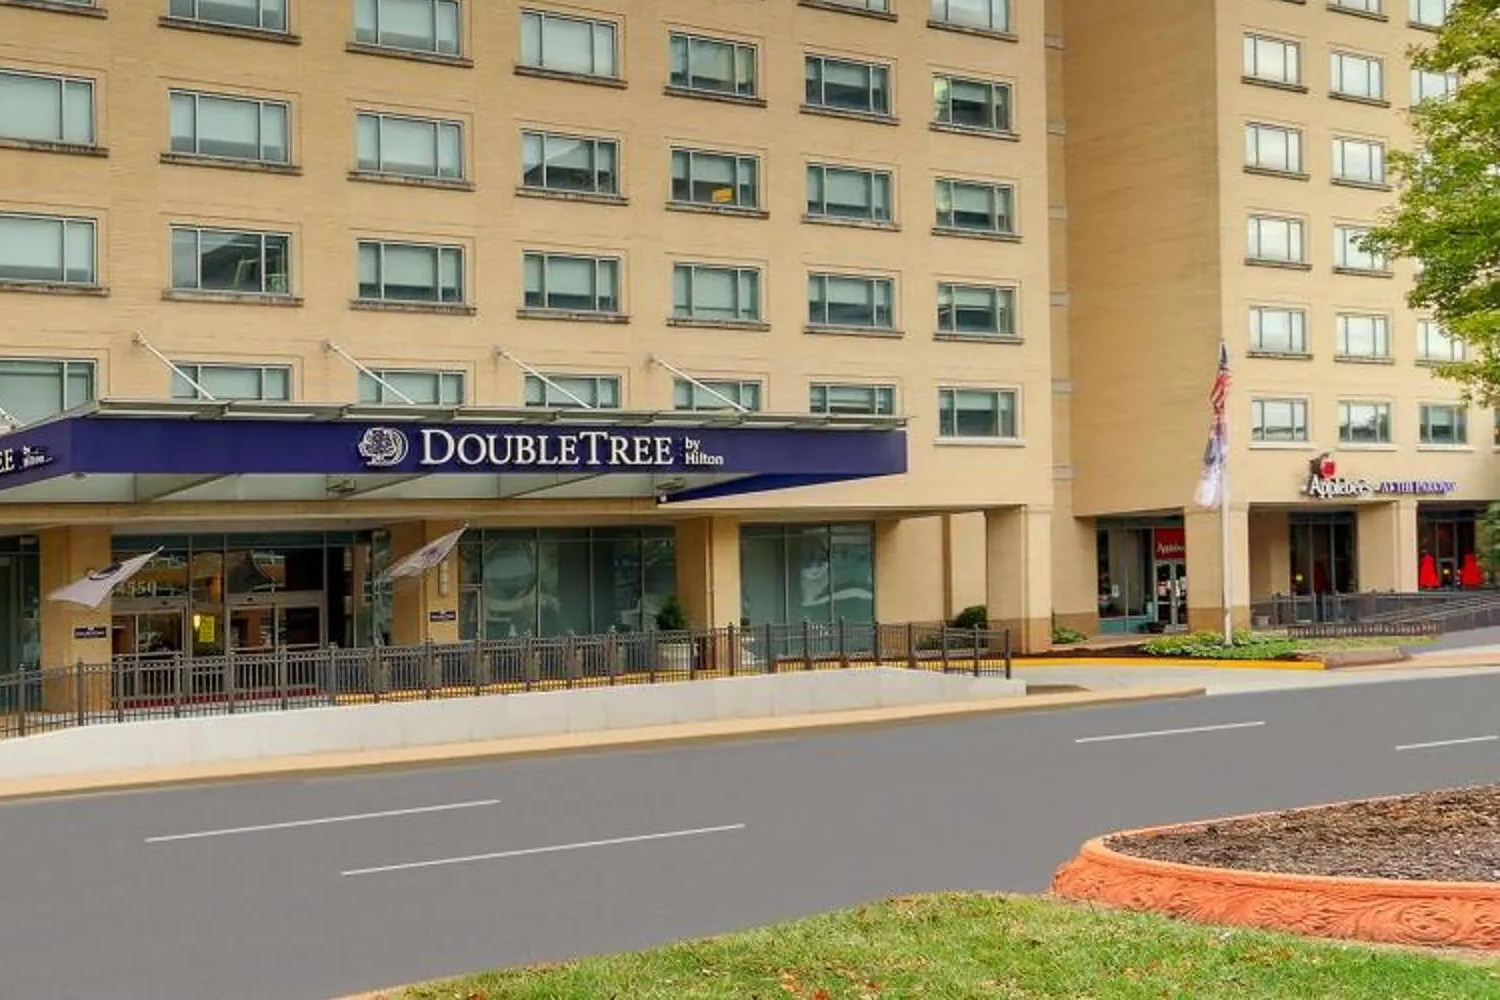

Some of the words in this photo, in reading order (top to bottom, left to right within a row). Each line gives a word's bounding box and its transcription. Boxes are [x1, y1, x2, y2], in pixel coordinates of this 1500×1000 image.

[419, 429, 674, 465] DOUBLETREE
[685, 436, 700, 452] by
[685, 452, 724, 465] Hilton
